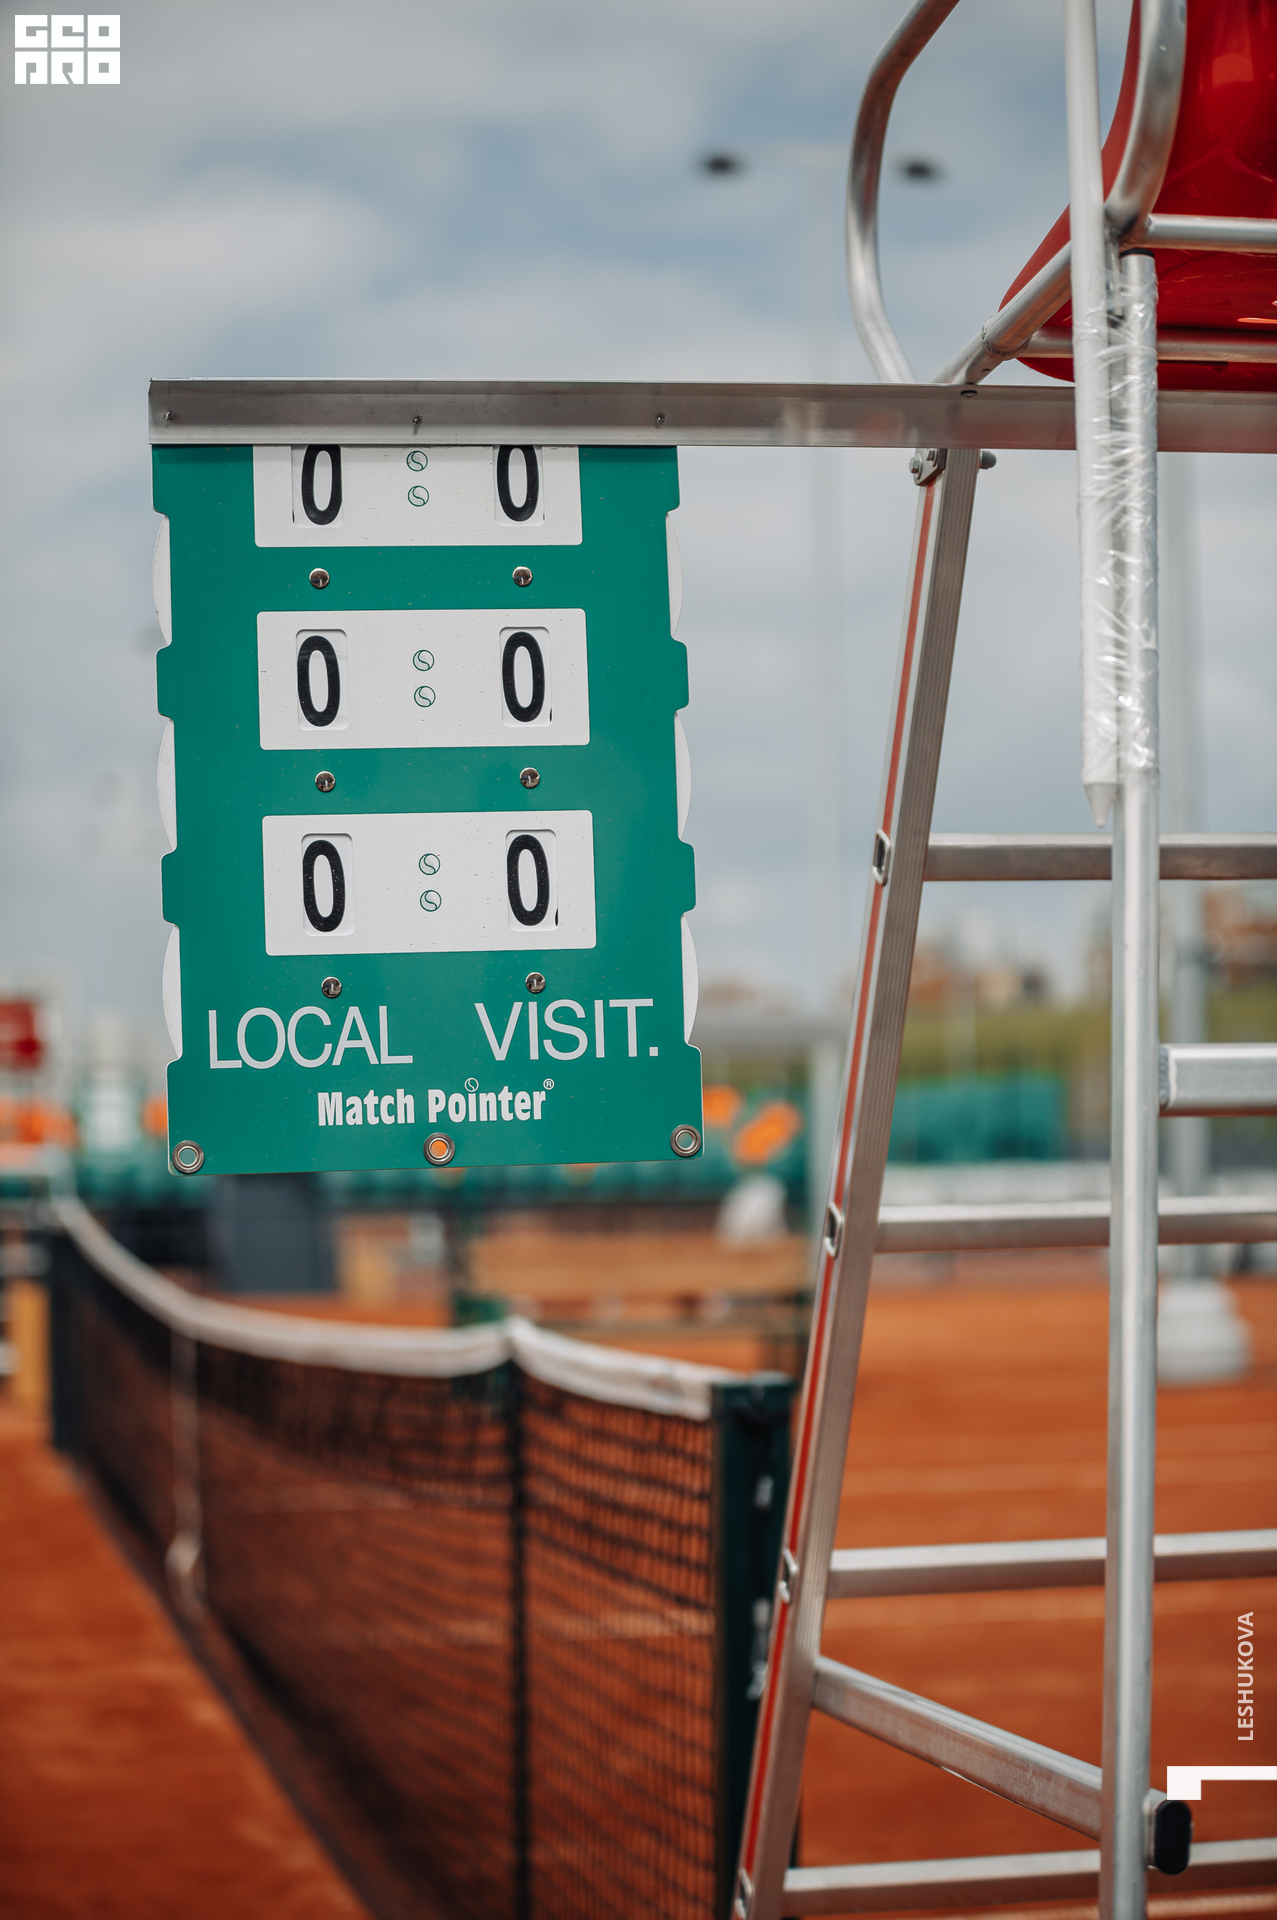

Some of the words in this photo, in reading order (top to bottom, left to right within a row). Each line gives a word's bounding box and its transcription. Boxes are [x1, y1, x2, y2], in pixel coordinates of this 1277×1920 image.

[301, 445, 343, 525] 0
[497, 445, 540, 522] 0
[297, 635, 340, 727] 0
[502, 631, 546, 723] 0
[302, 839, 346, 933] 0
[506, 834, 550, 927] 0
[208, 1005, 413, 1069] LOCAL
[474, 998, 660, 1061] VISIT.
[317, 1088, 415, 1127] Match
